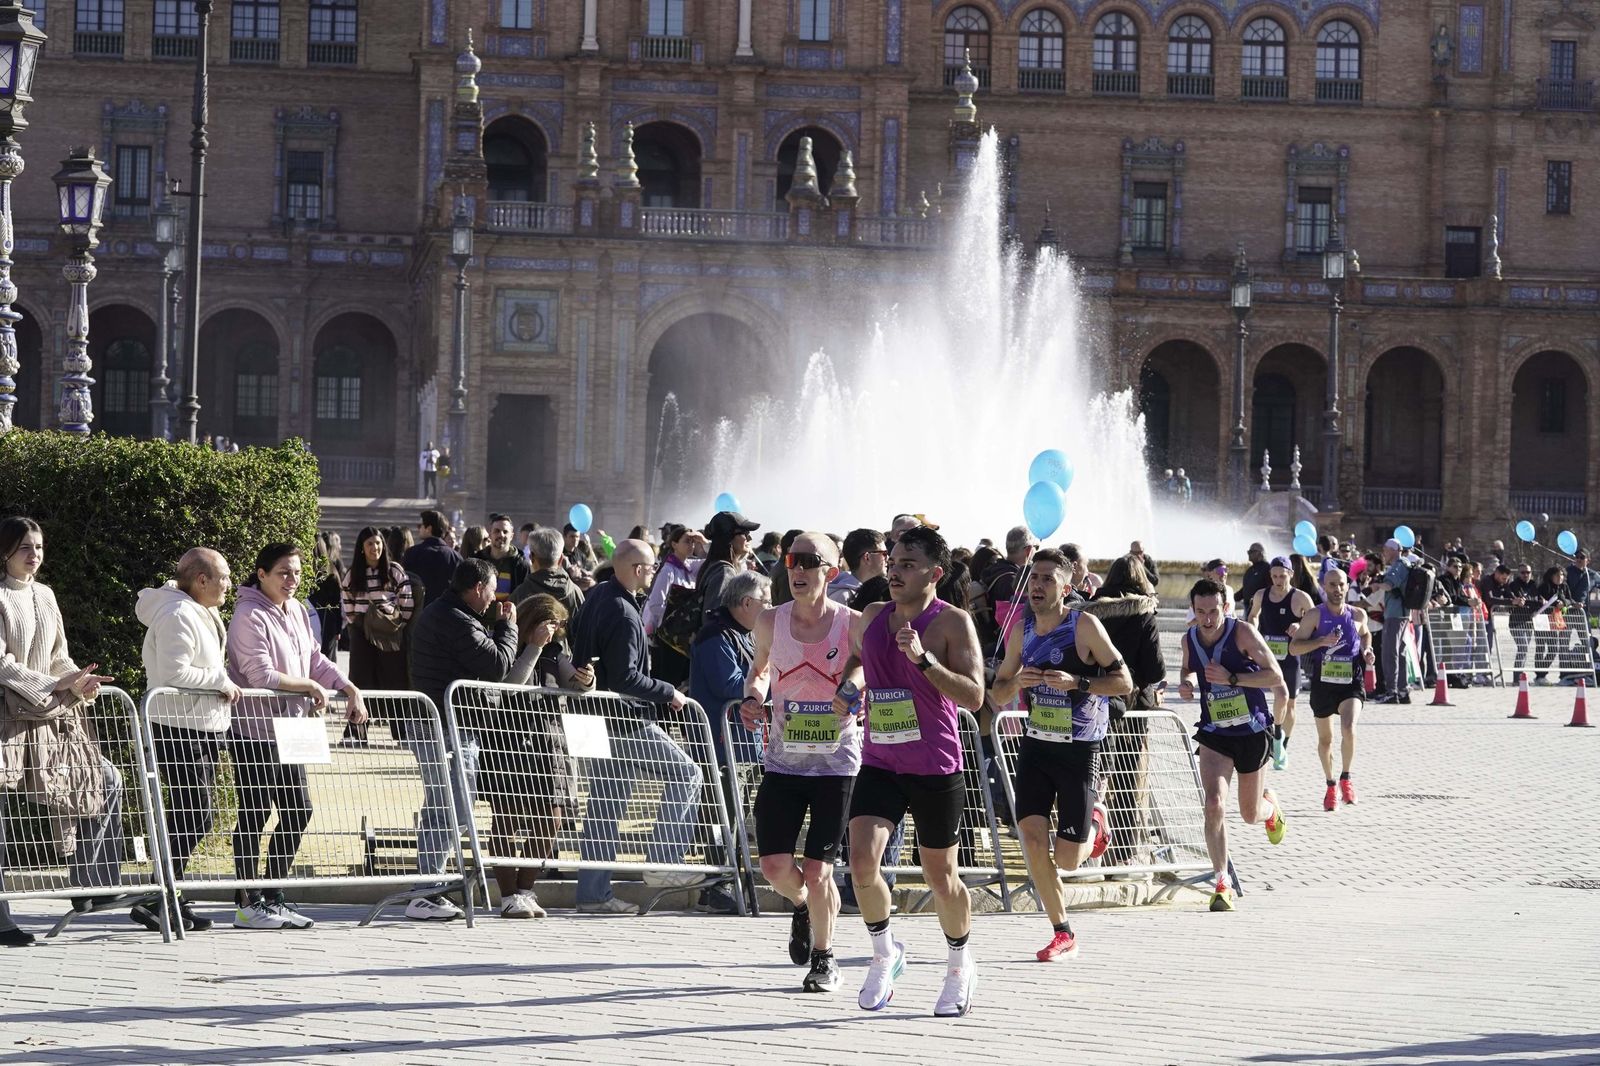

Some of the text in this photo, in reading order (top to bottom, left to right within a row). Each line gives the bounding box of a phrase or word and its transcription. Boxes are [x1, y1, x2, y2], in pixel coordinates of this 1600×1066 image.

[875, 691, 905, 700] ZURICH
[1216, 689, 1239, 698] ZURICH
[1039, 697, 1066, 706] ZURICH
[803, 704, 834, 712] ZURICH
[879, 708, 894, 717] 1622
[1216, 708, 1240, 719] BRENT
[805, 719, 821, 728] 1638
[883, 719, 919, 731] GUIRAUD
[787, 729, 836, 741] THIBAULT
